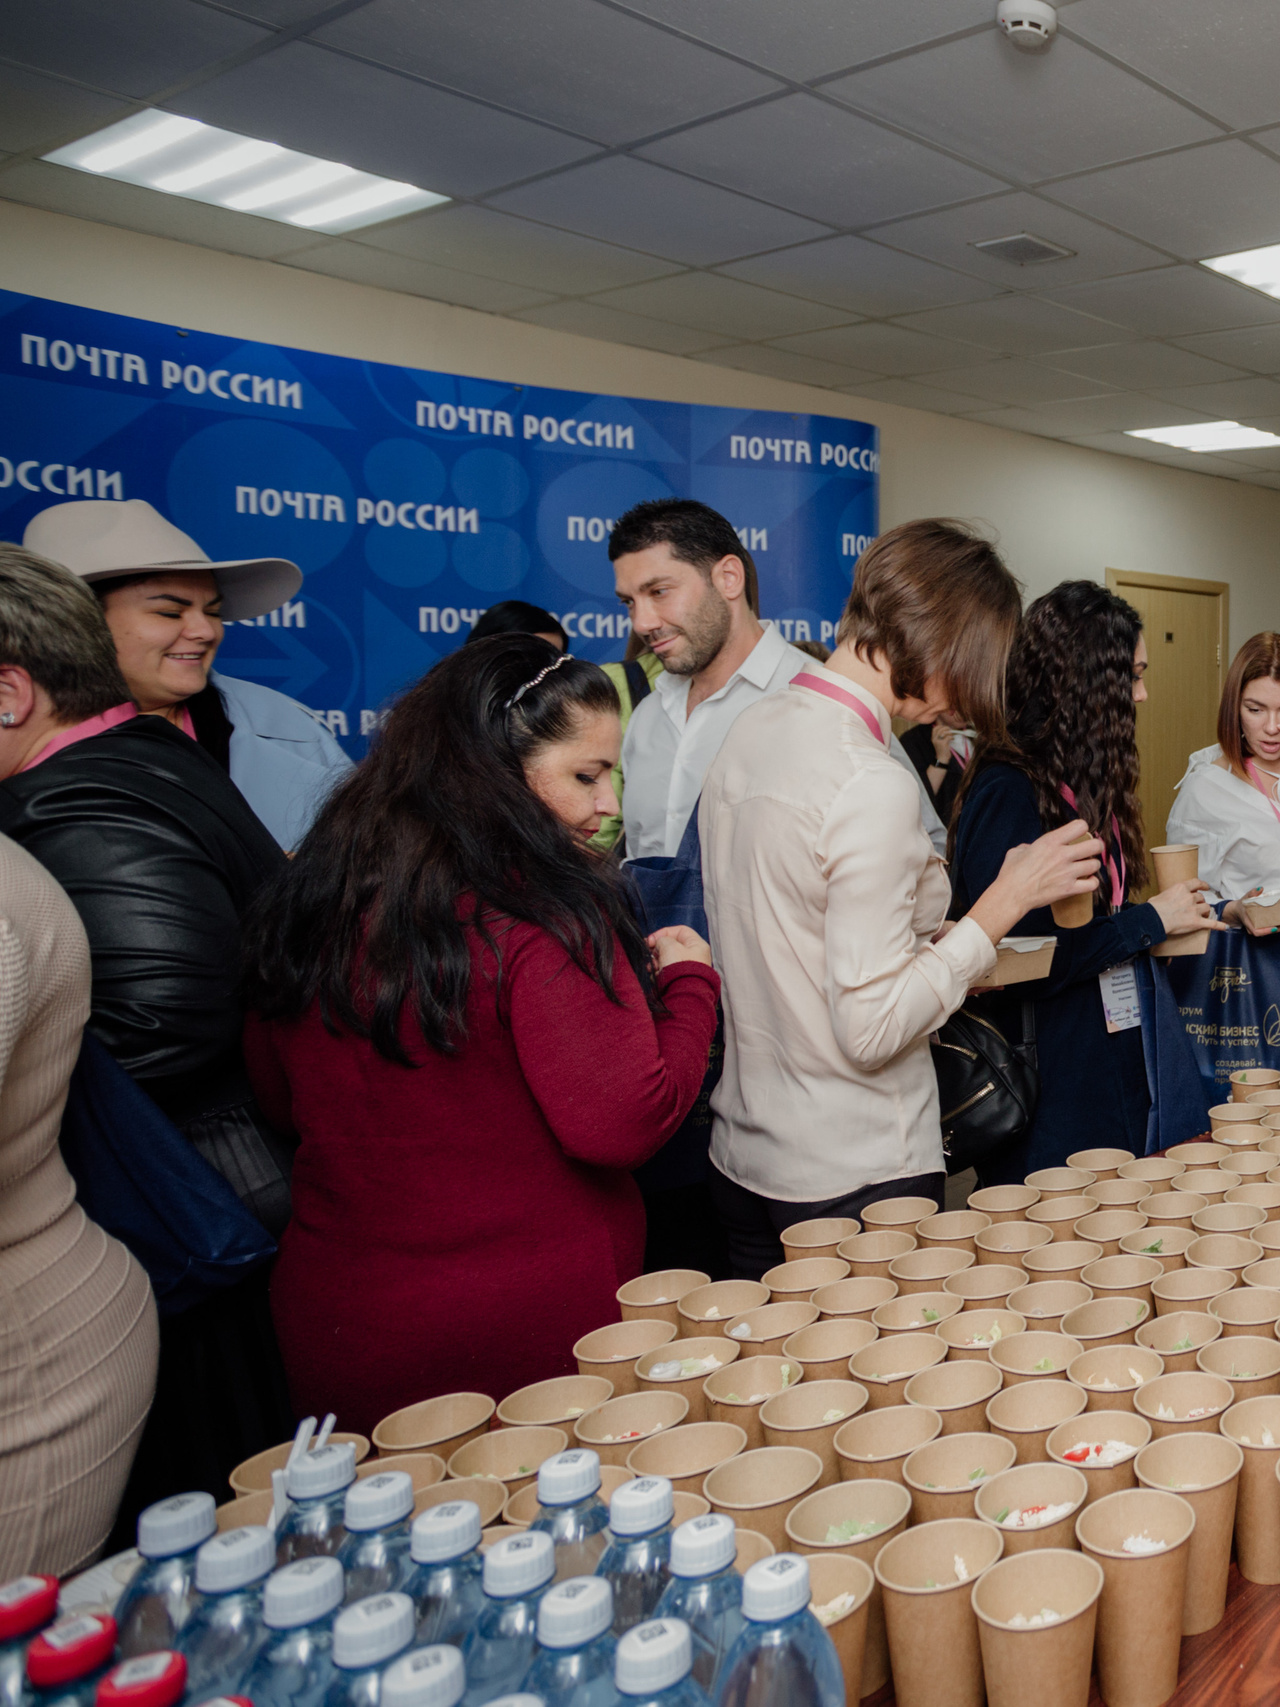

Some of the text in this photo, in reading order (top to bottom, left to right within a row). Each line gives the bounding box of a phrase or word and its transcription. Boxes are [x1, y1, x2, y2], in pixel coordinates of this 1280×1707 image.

[21, 333, 303, 410] ПОЧТА РОССИИ
[416, 400, 635, 450] ПОЧТА РОССИИ
[730, 434, 880, 475] ПОЧТА РОССИ
[0, 456, 123, 500] ОССИИ
[235, 485, 479, 534] ПОЧТА РОССИИ
[419, 606, 488, 635] ПОЧ
[1185, 1023, 1260, 1037] СКИЙ БИЗНЕС
[1196, 1035, 1218, 1047] Путь
[1227, 1039, 1259, 1048] успеху
[1215, 1058, 1256, 1068] создавай
